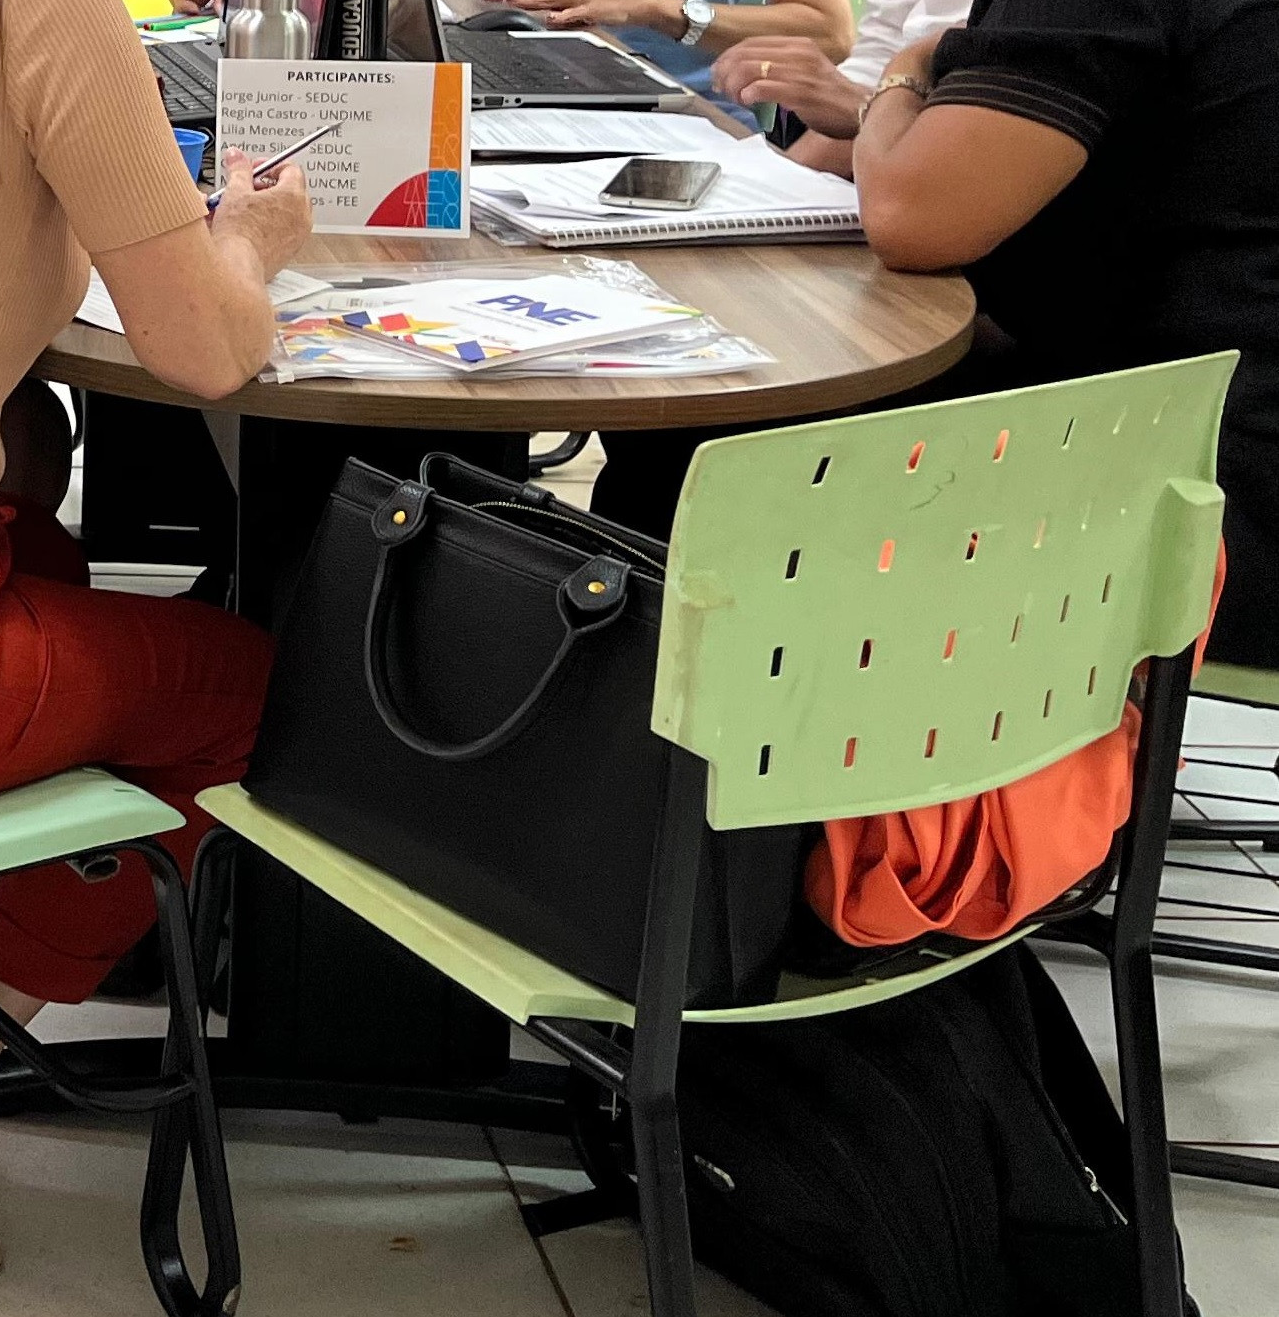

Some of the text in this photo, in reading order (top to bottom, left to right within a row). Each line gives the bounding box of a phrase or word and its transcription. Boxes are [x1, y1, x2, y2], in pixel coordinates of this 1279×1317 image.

[287, 70, 395, 84] PARTICIPANTES:
[221, 90, 254, 105] Jorge
[256, 91, 294, 104] Junior
[305, 92, 349, 104] SEDUC
[221, 107, 263, 121] Regina
[266, 107, 308, 120] Castro
[319, 109, 373, 122] UNDIME
[221, 124, 246, 136] Lilia
[249, 124, 305, 137] Menezes
[308, 143, 354, 155] SEDUC
[306, 160, 361, 173] UNDIME
[308, 178, 358, 190] UNCME
[336, 195, 360, 207] FEE
